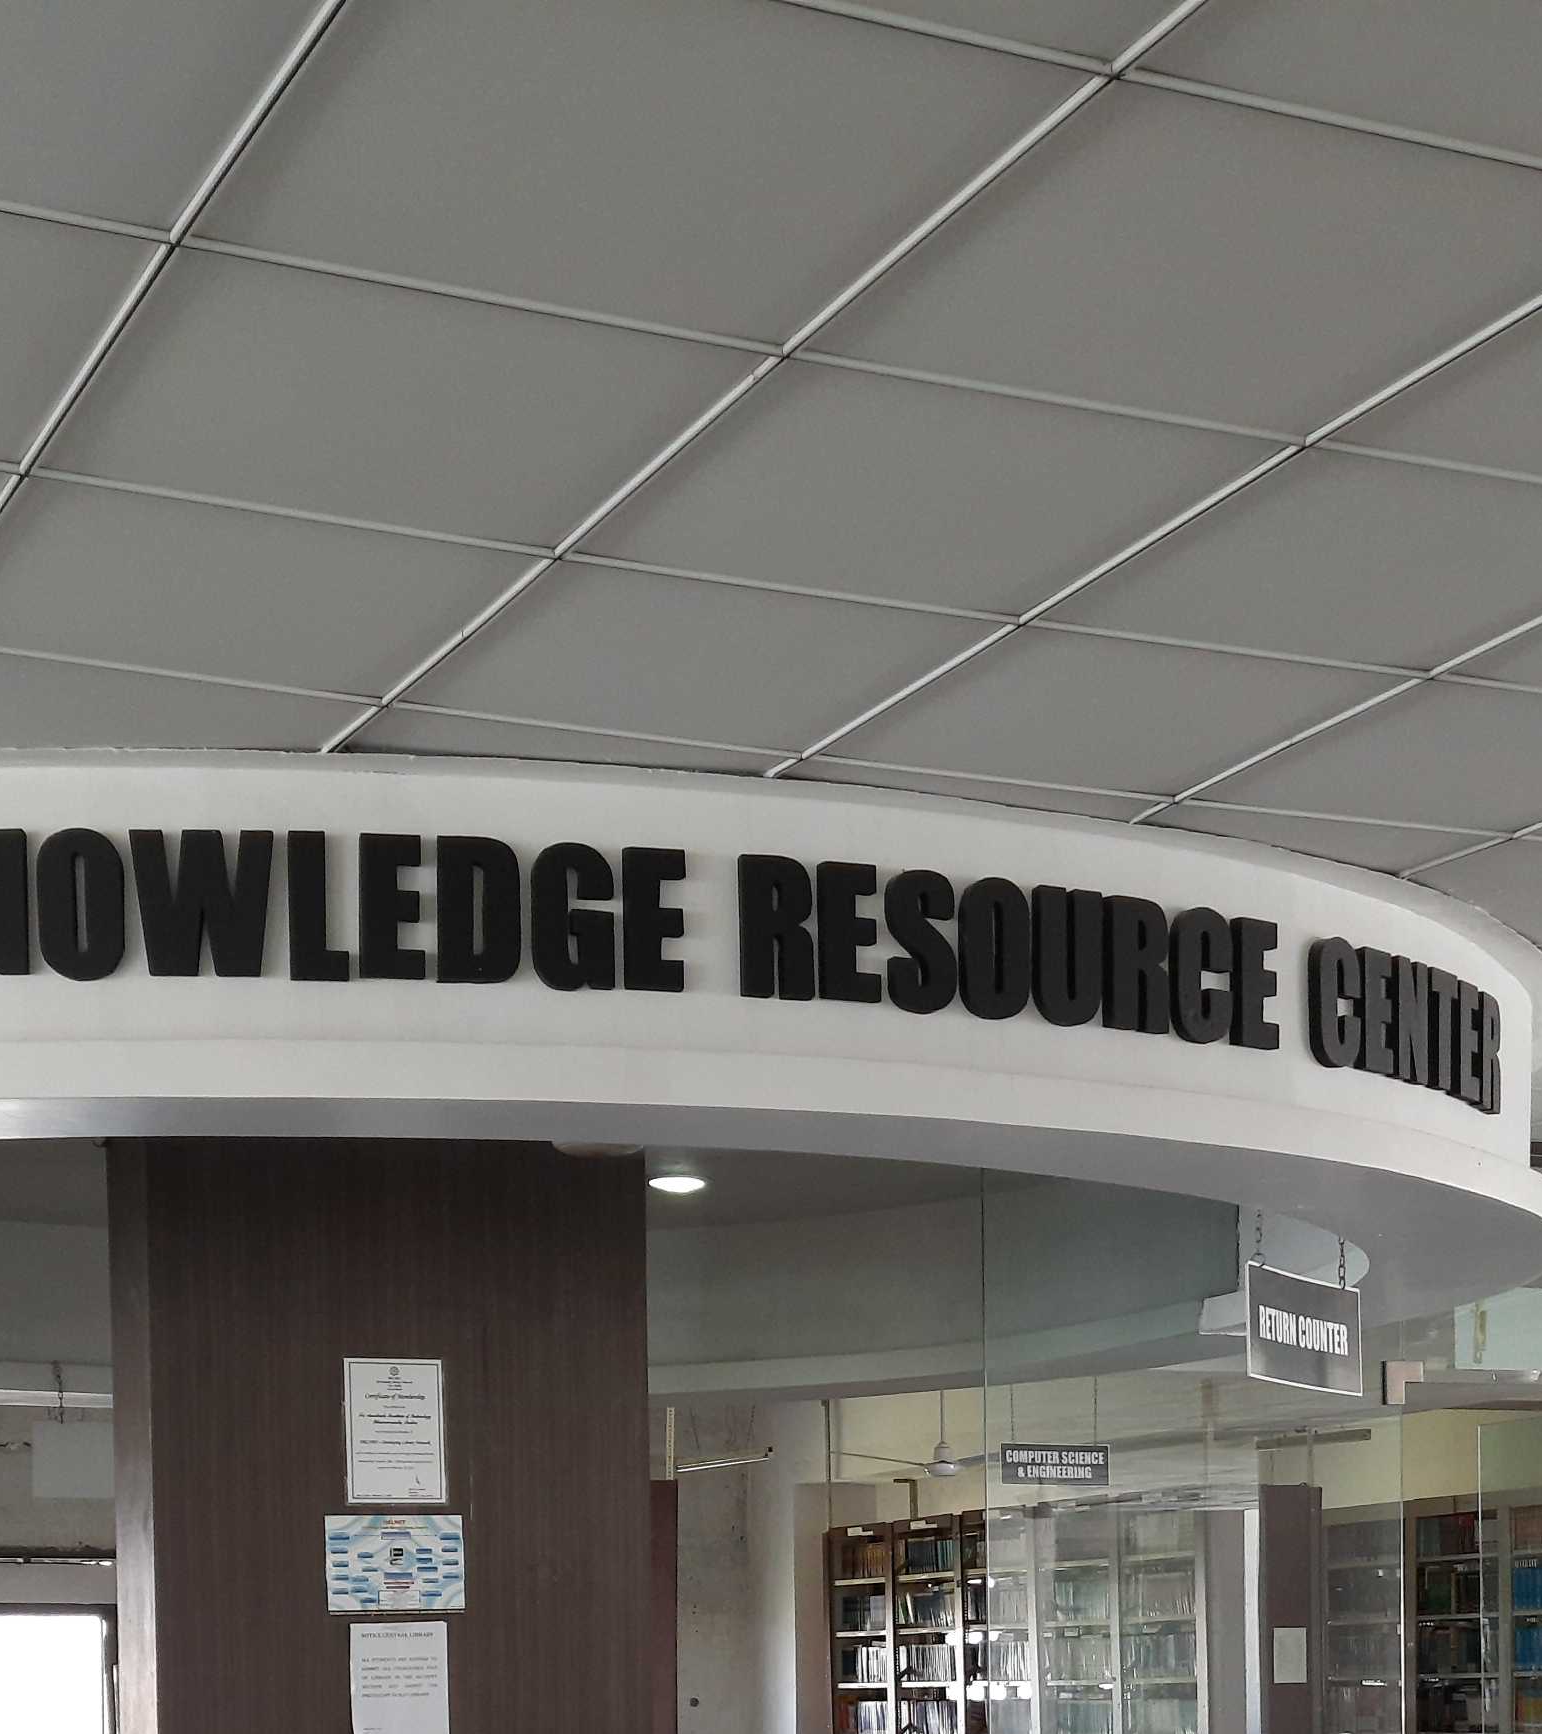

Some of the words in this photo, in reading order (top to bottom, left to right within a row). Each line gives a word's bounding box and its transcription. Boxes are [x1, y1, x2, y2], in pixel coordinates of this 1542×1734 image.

[737, 853, 1280, 1051] RESOURCE
[1307, 935, 1502, 1115] CENTER
[1258, 1304, 1297, 1346] RETURN
[1298, 1315, 1349, 1356] COUNTER
[1005, 1449, 1060, 1464] COMPUTER
[1061, 1451, 1106, 1465] SCIENCE
[1017, 1466, 1026, 1478] &
[1026, 1465, 1093, 1479] ENGINEERING
